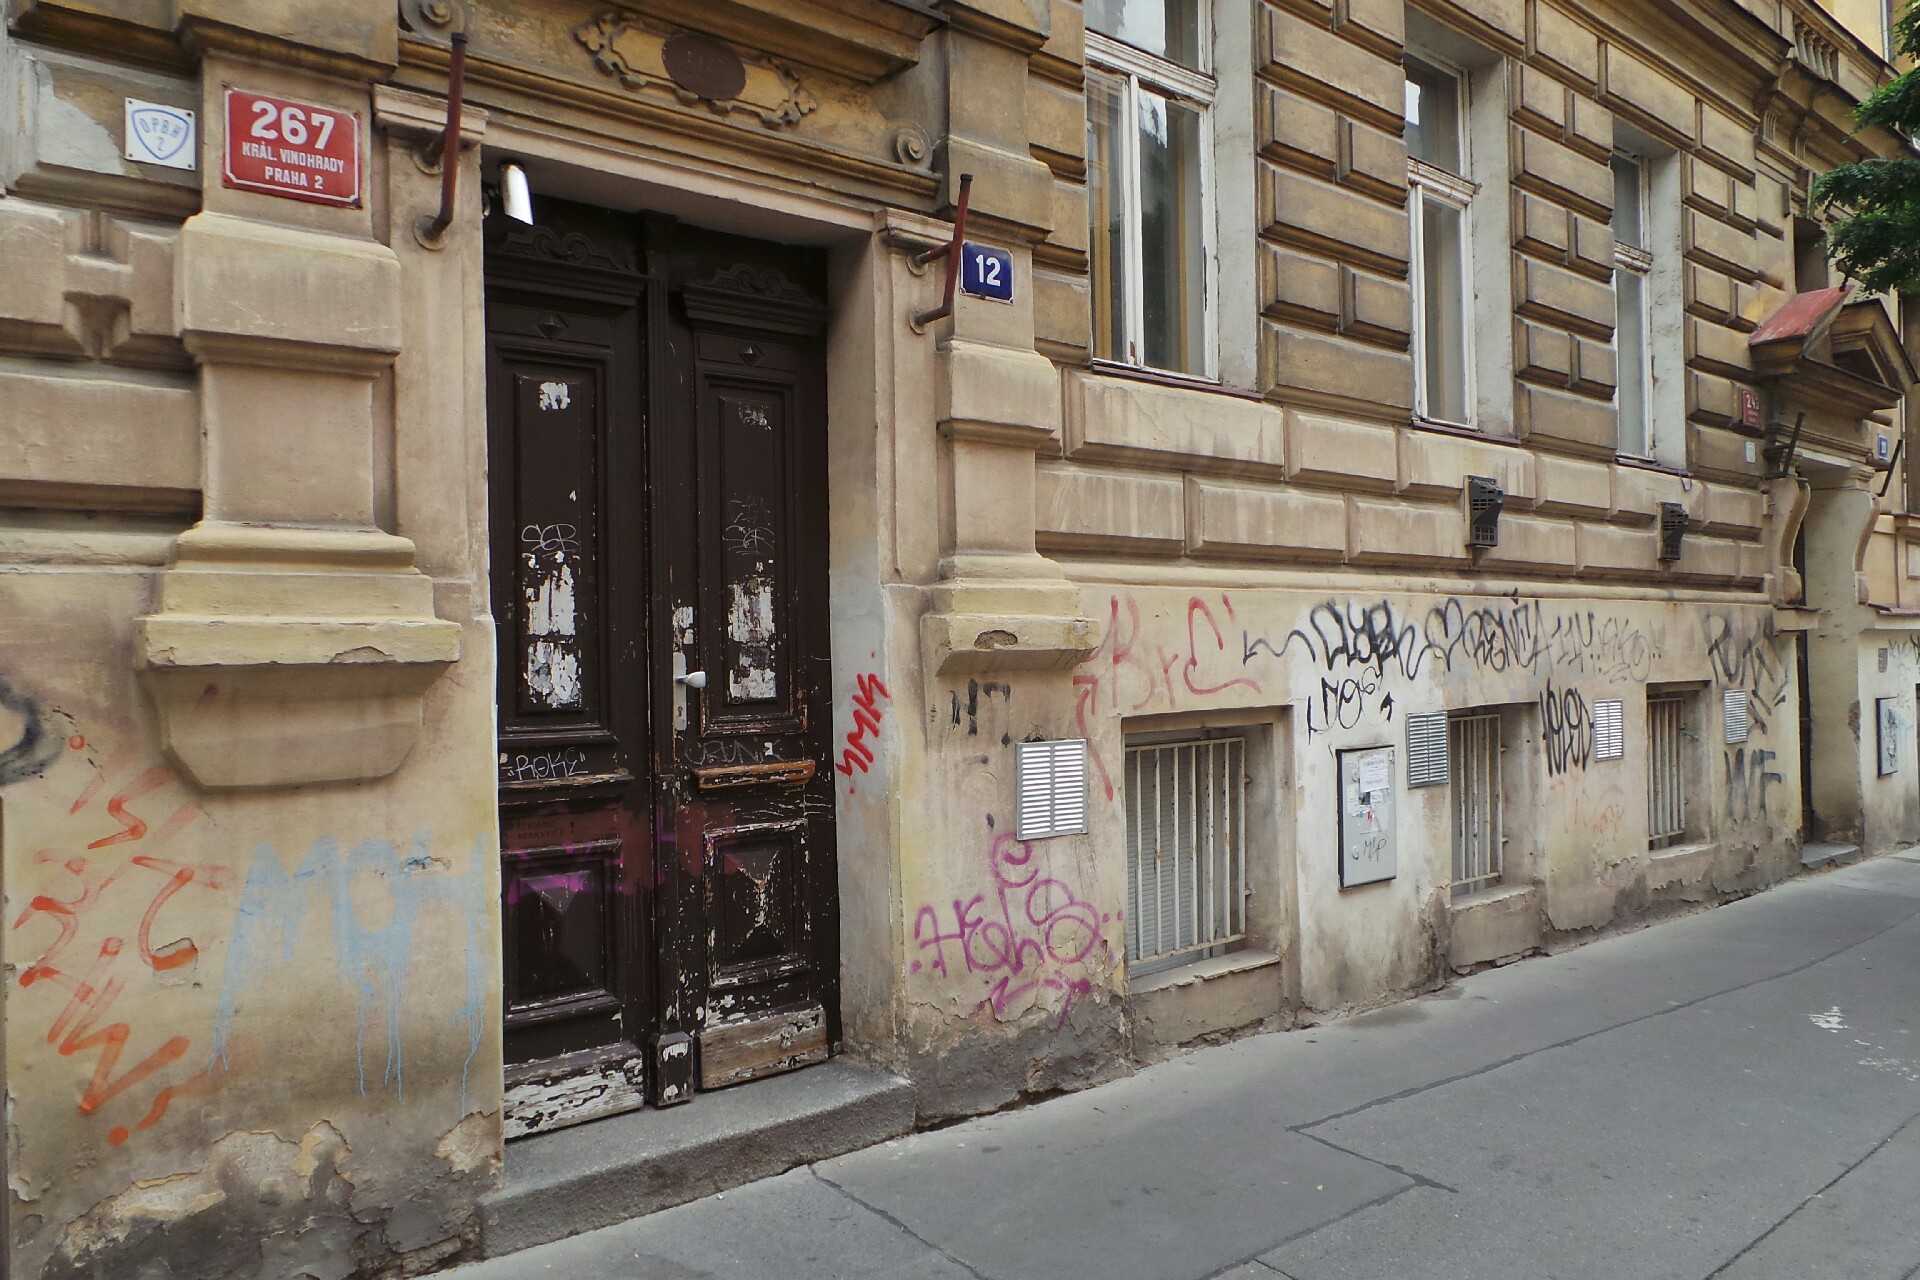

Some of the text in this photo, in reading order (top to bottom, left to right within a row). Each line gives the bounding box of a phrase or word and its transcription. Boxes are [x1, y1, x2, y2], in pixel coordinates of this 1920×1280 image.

[250, 100, 335, 150] 267
[280, 148, 344, 173] VINOHRADY
[265, 166, 323, 190] PRAHA 2
[976, 254, 1001, 287] 12
